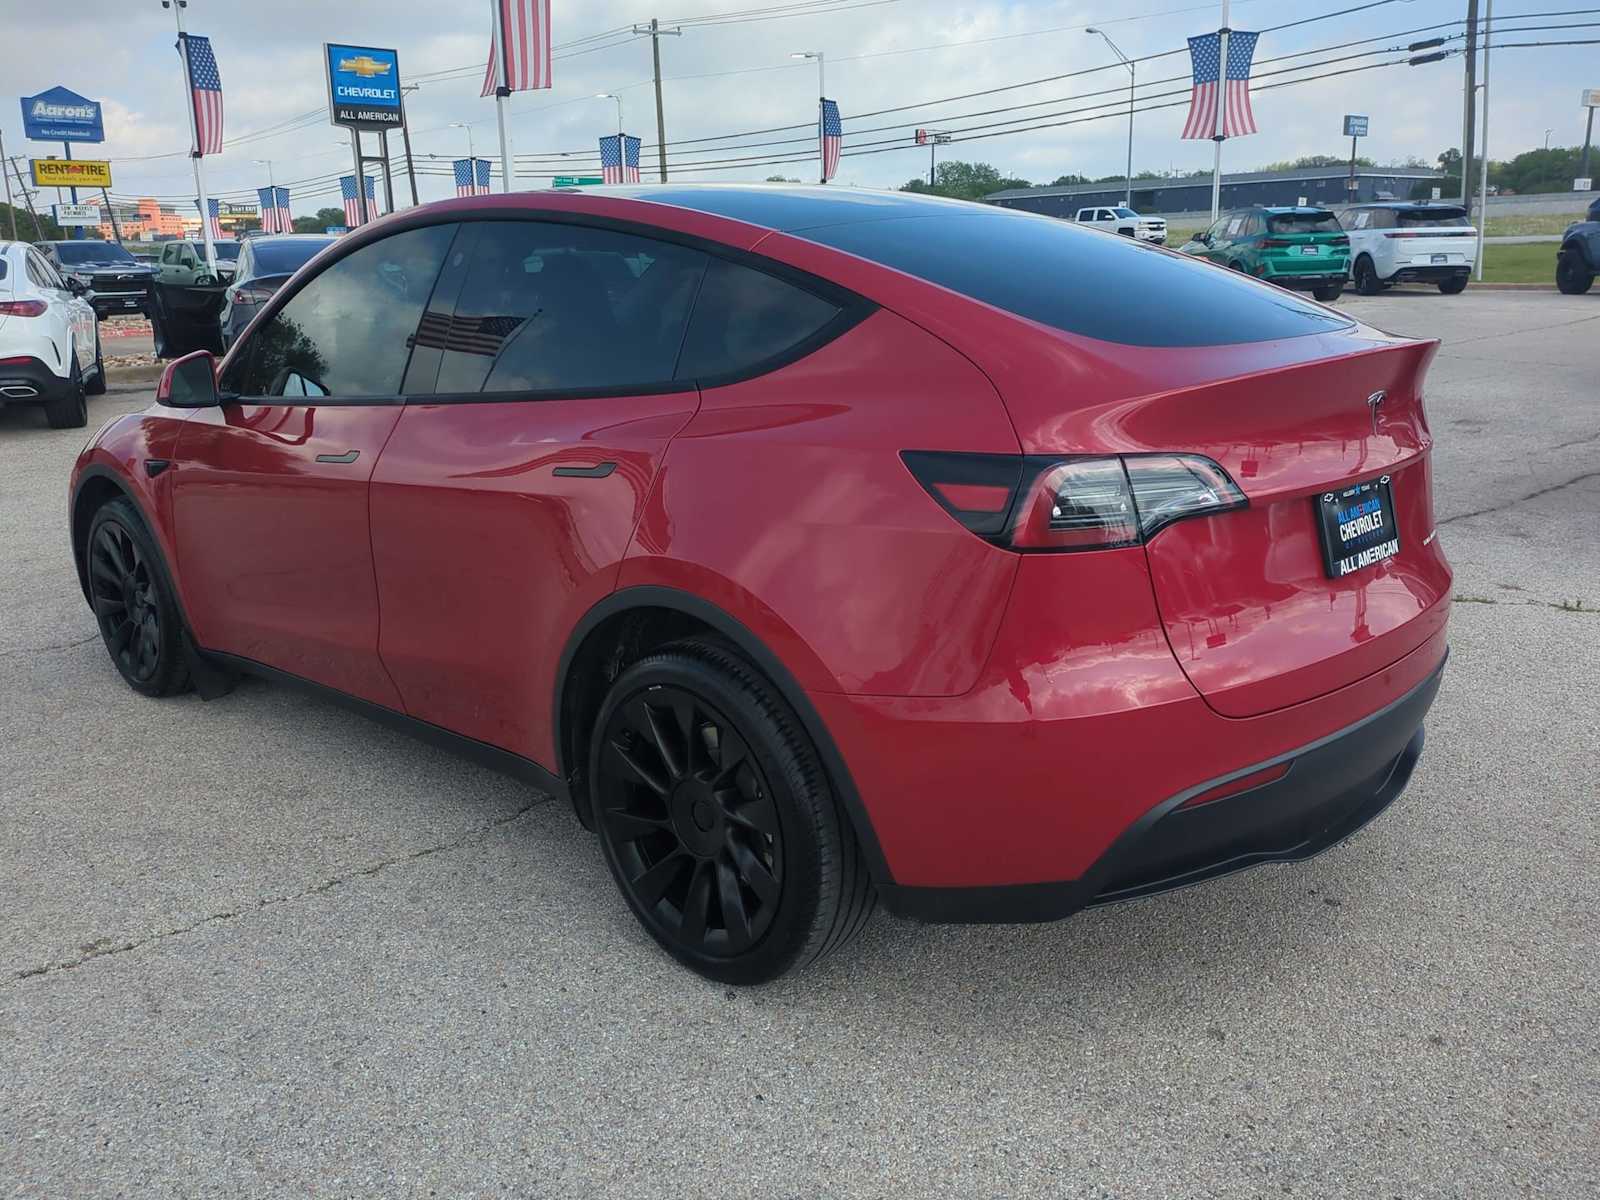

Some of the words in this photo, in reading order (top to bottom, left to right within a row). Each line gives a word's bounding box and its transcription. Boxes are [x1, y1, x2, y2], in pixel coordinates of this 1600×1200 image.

[338, 86, 396, 99] CHEVROLET
[32, 100, 96, 118] Aaron's
[340, 110, 356, 120] ALL
[358, 111, 399, 122] AMERICAN
[38, 163, 70, 175] RENT
[79, 164, 106, 176] TIRE
[1338, 507, 1351, 524] ALL
[1350, 498, 1381, 519] AMERICAN
[1339, 510, 1383, 542] CHEVROLET
[1340, 555, 1358, 576] ALL
[1358, 539, 1399, 569] AMERICAN
